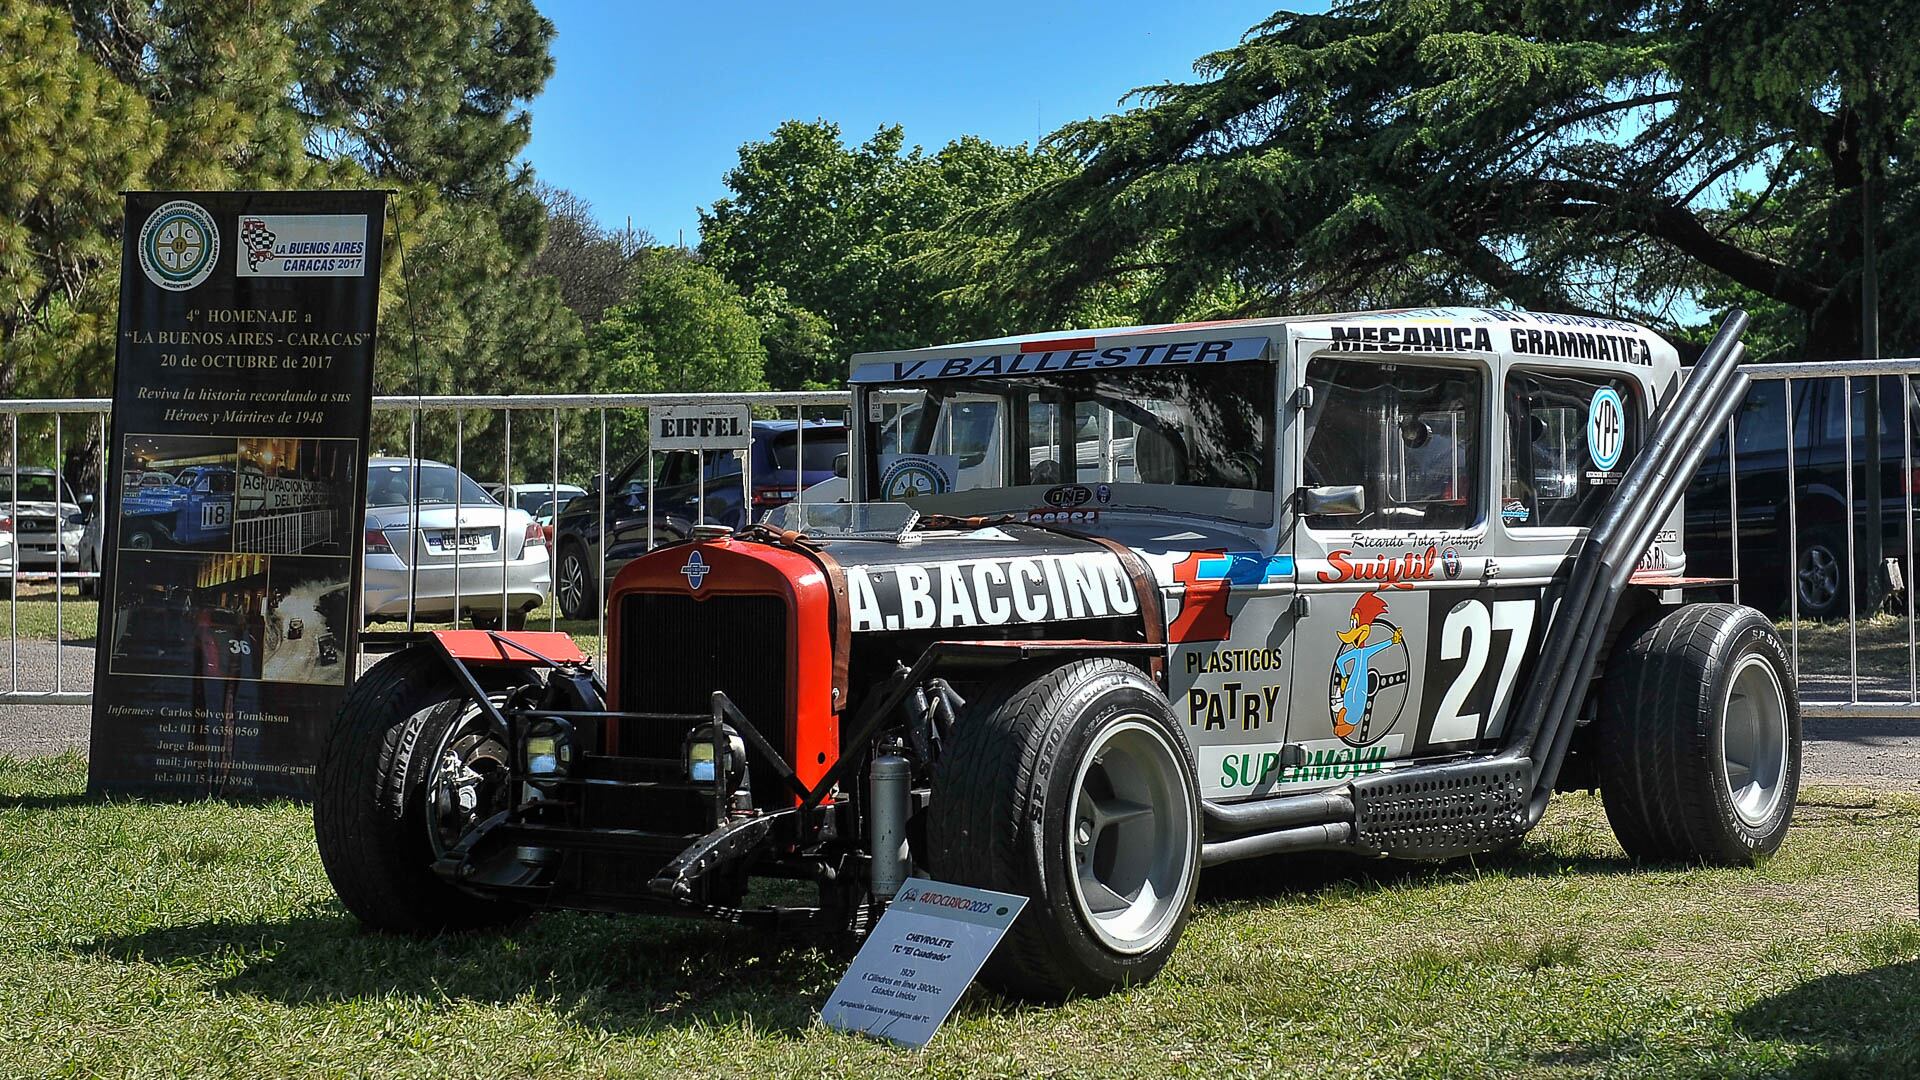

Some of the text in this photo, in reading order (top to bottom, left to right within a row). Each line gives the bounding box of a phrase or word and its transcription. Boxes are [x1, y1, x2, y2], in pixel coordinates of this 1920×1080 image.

[275, 241, 363, 254] LA BUENOS AIRES
[283, 259, 362, 272] CARACAS 2017
[208, 309, 297, 323] HOMENAJE
[304, 313, 312, 323] a
[1528, 312, 1638, 333] RADIADORES
[158, 331, 223, 345] BUENOS
[226, 333, 274, 346] AIRES
[1330, 326, 1653, 367] MECANICA GRAMMATICA
[160, 354, 333, 369] 20 de OCTUBRE de 2017
[893, 340, 1233, 381] V. BALLESTER
[137, 387, 351, 402] Reviva la historia recordando a sus
[164, 408, 324, 424] Héroes y Mártires de 1948
[661, 417, 743, 438] EIFFEL
[1595, 400, 1619, 457] YPF
[202, 505, 225, 526] 118
[1351, 532, 1404, 549] Ricardo
[1317, 546, 1437, 589] Suixtil
[229, 639, 251, 655] 36
[1186, 649, 1282, 674] PLASTICOS
[1428, 599, 1537, 745] 27
[107, 704, 289, 723] Informes: Carlos Solveyra Tomkinson
[1188, 682, 1281, 731] PATRY
[180, 724, 196, 734] 011
[199, 725, 210, 735] 15
[235, 727, 259, 737] 0569
[157, 740, 226, 753] Jorge Bonomo
[175, 773, 191, 783] 011
[229, 776, 254, 787] 8948
[905, 932, 955, 949] CHEVROLETE
[867, 973, 893, 986] Cilindros
[900, 968, 915, 977] 1929
[871, 985, 918, 1002] Estados Unidos
